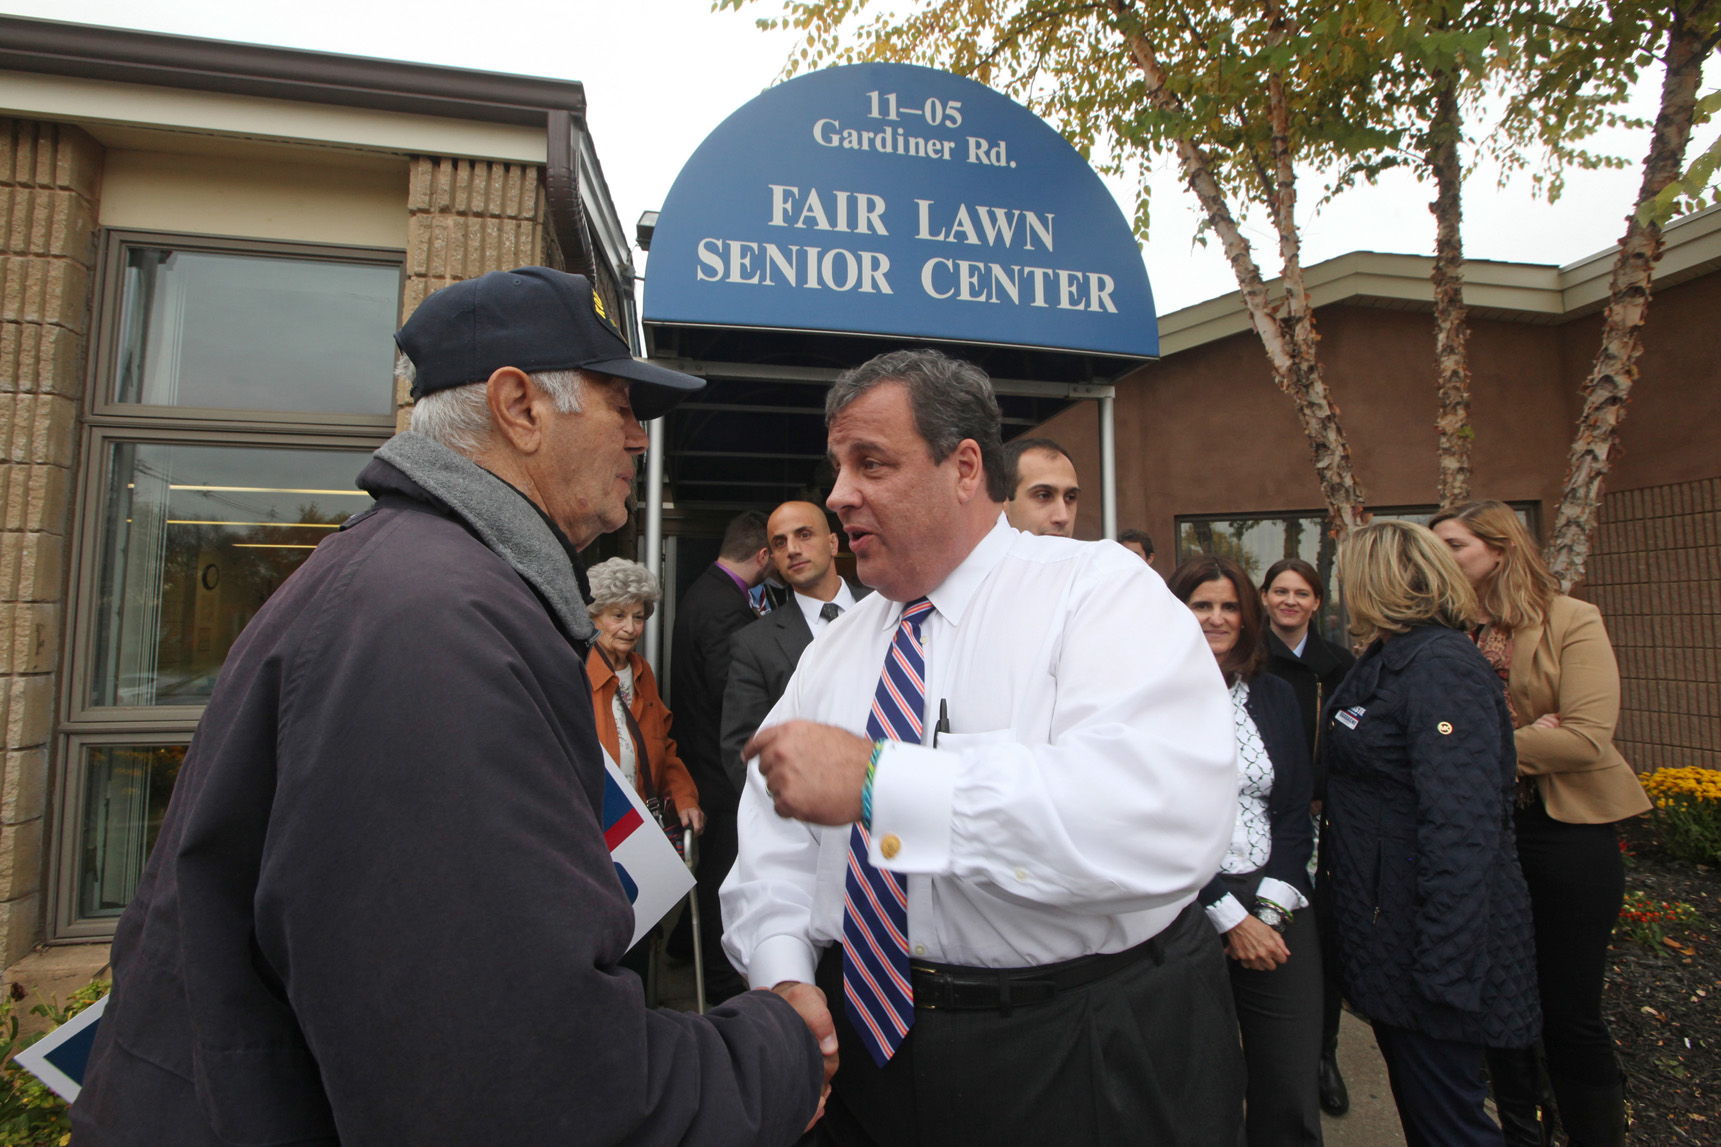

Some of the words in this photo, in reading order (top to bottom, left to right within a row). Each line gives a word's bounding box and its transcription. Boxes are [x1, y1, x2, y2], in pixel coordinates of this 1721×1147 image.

[812, 118, 955, 160] Gardiner
[966, 136, 1017, 168] Rd.
[767, 184, 889, 236] FAIR
[914, 199, 1055, 252] LAWN
[697, 237, 894, 294] SENIOR
[921, 257, 1119, 313] CENTER
